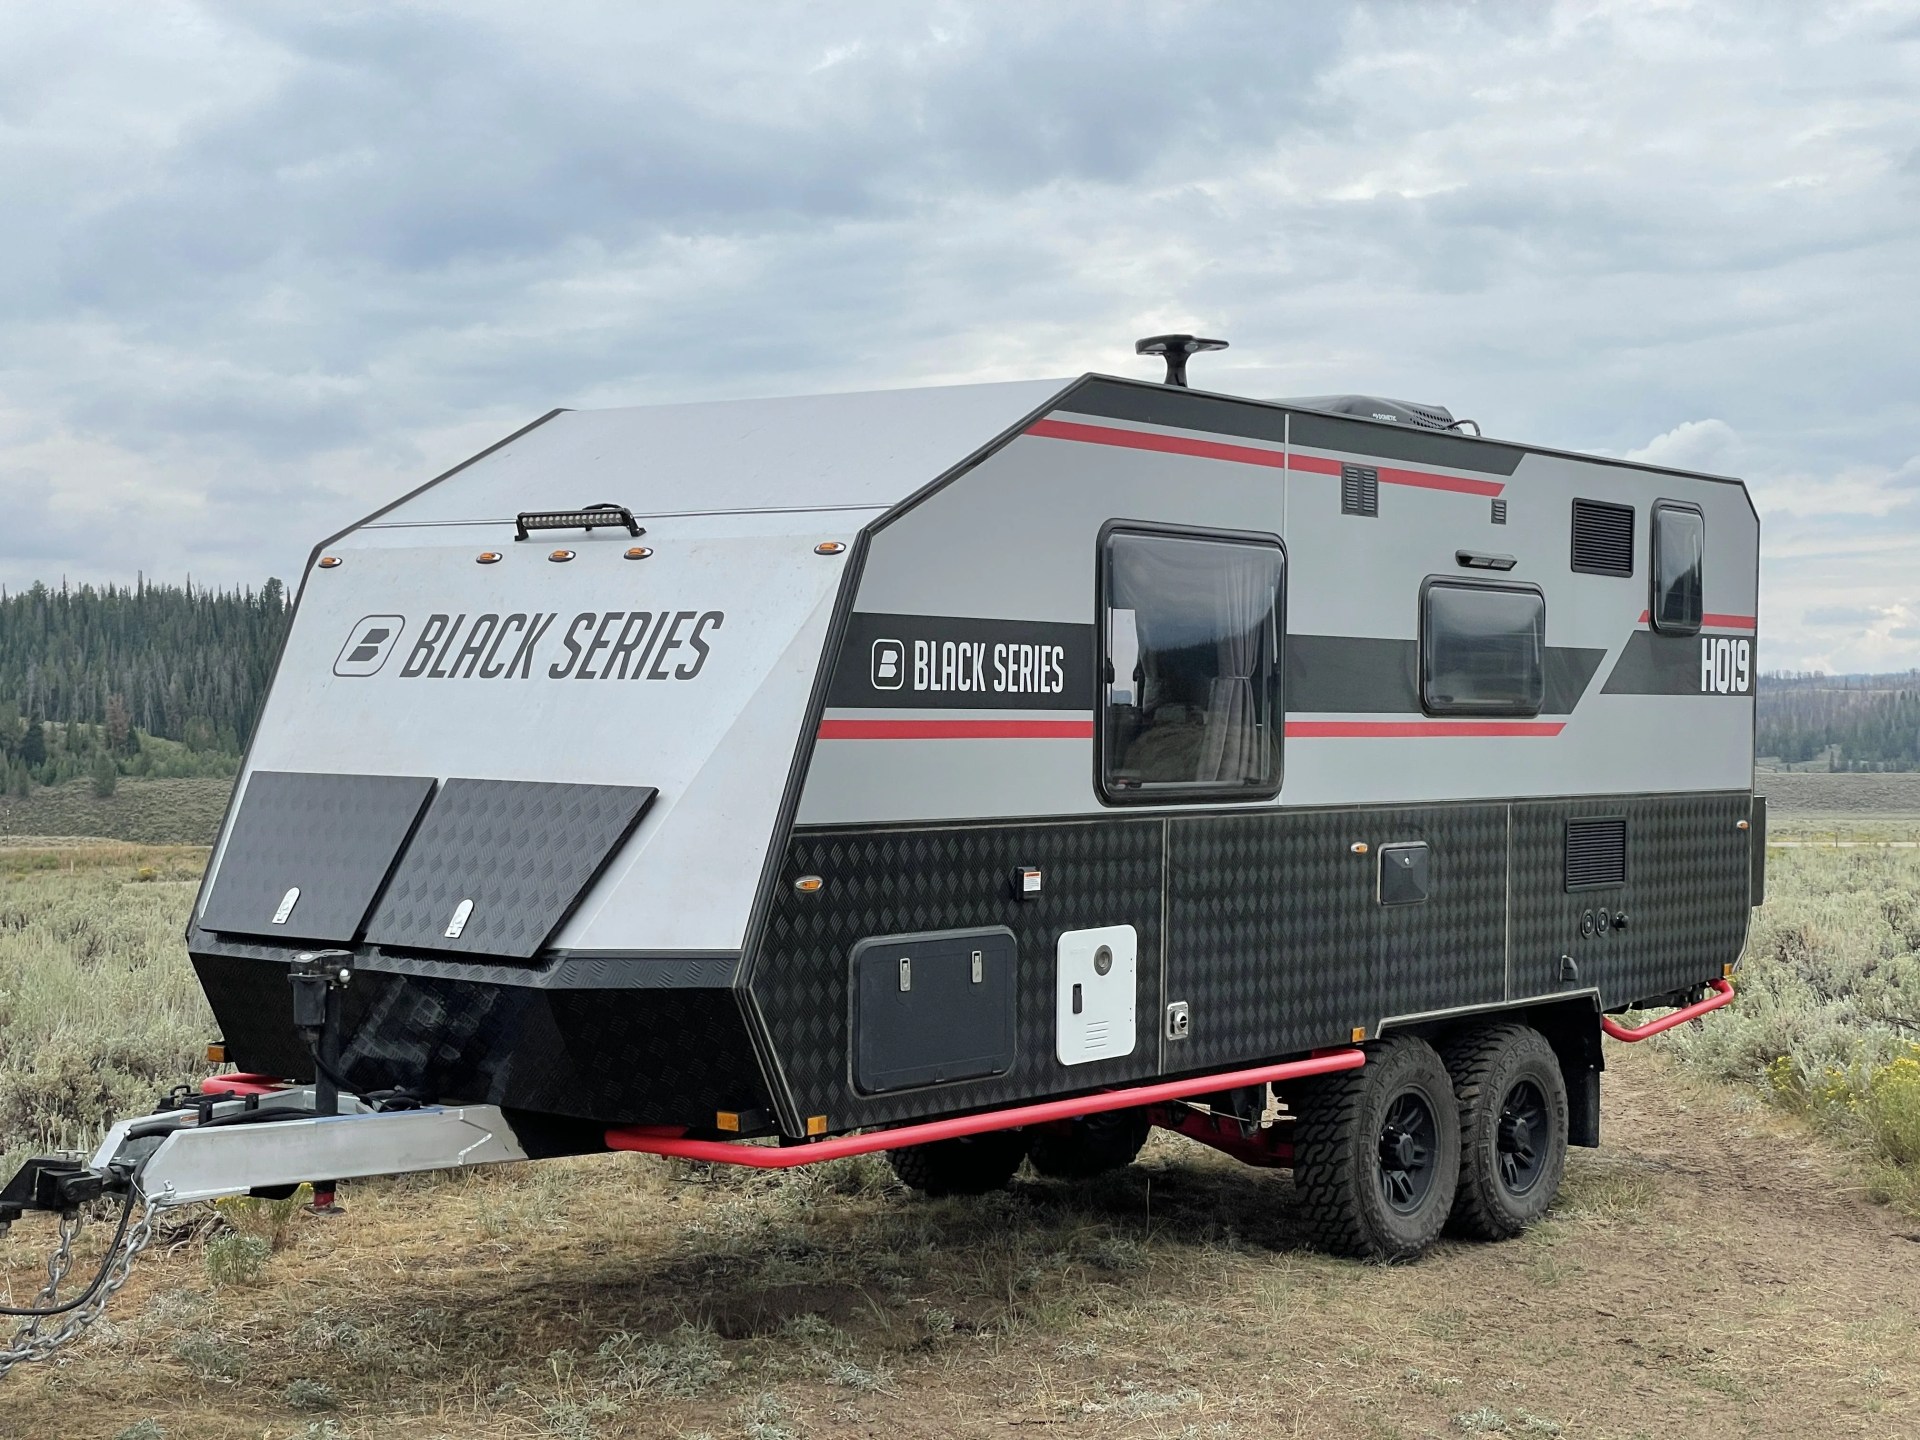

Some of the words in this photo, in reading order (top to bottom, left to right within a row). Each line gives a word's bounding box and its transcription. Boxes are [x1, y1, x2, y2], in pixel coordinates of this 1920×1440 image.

[399, 612, 558, 679] BLACK
[548, 610, 725, 680] SERIES
[914, 640, 986, 692] BLACK
[993, 643, 1065, 694] SERIES
[1701, 637, 1750, 694] HQ19
